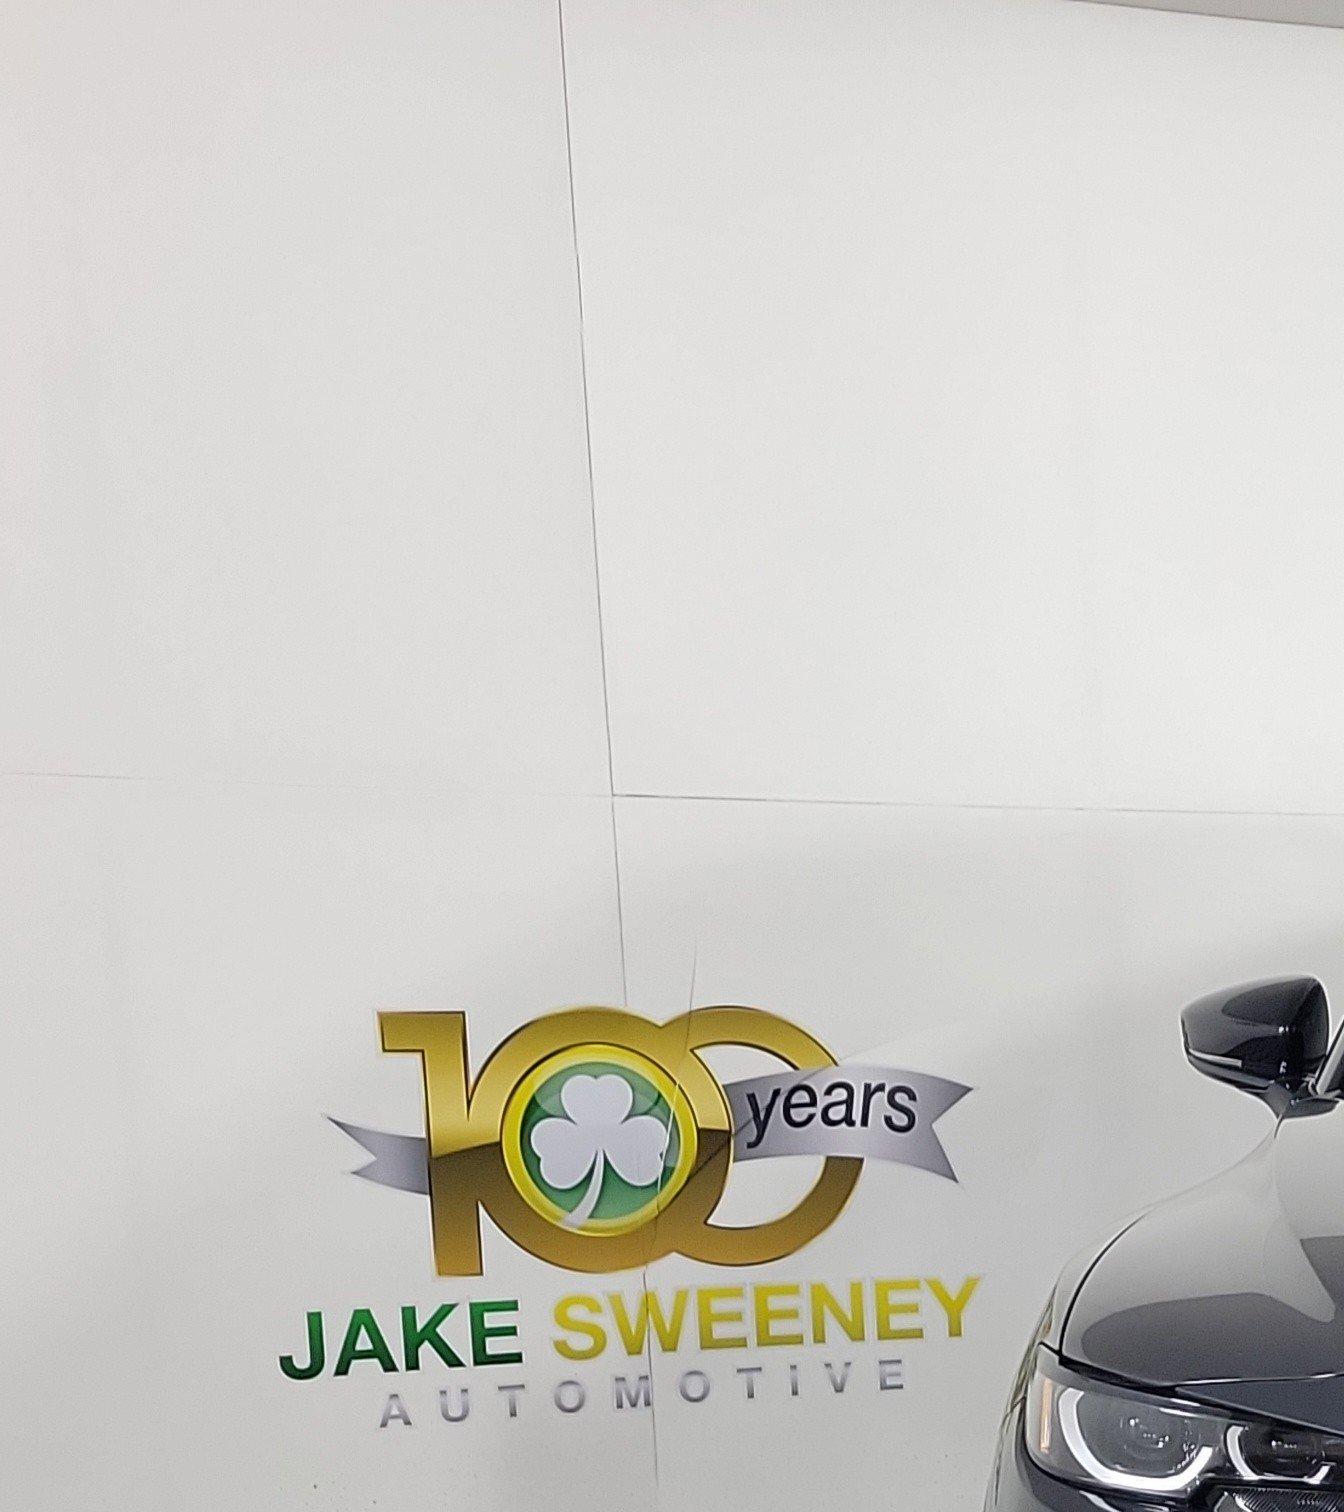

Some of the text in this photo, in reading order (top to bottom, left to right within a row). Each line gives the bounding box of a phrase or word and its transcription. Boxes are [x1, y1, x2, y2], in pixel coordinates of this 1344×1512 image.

[745, 1081, 918, 1149] years
[279, 1276, 982, 1381] JAKE SWEENEY
[378, 1359, 905, 1428] AUTOMOTIVE
